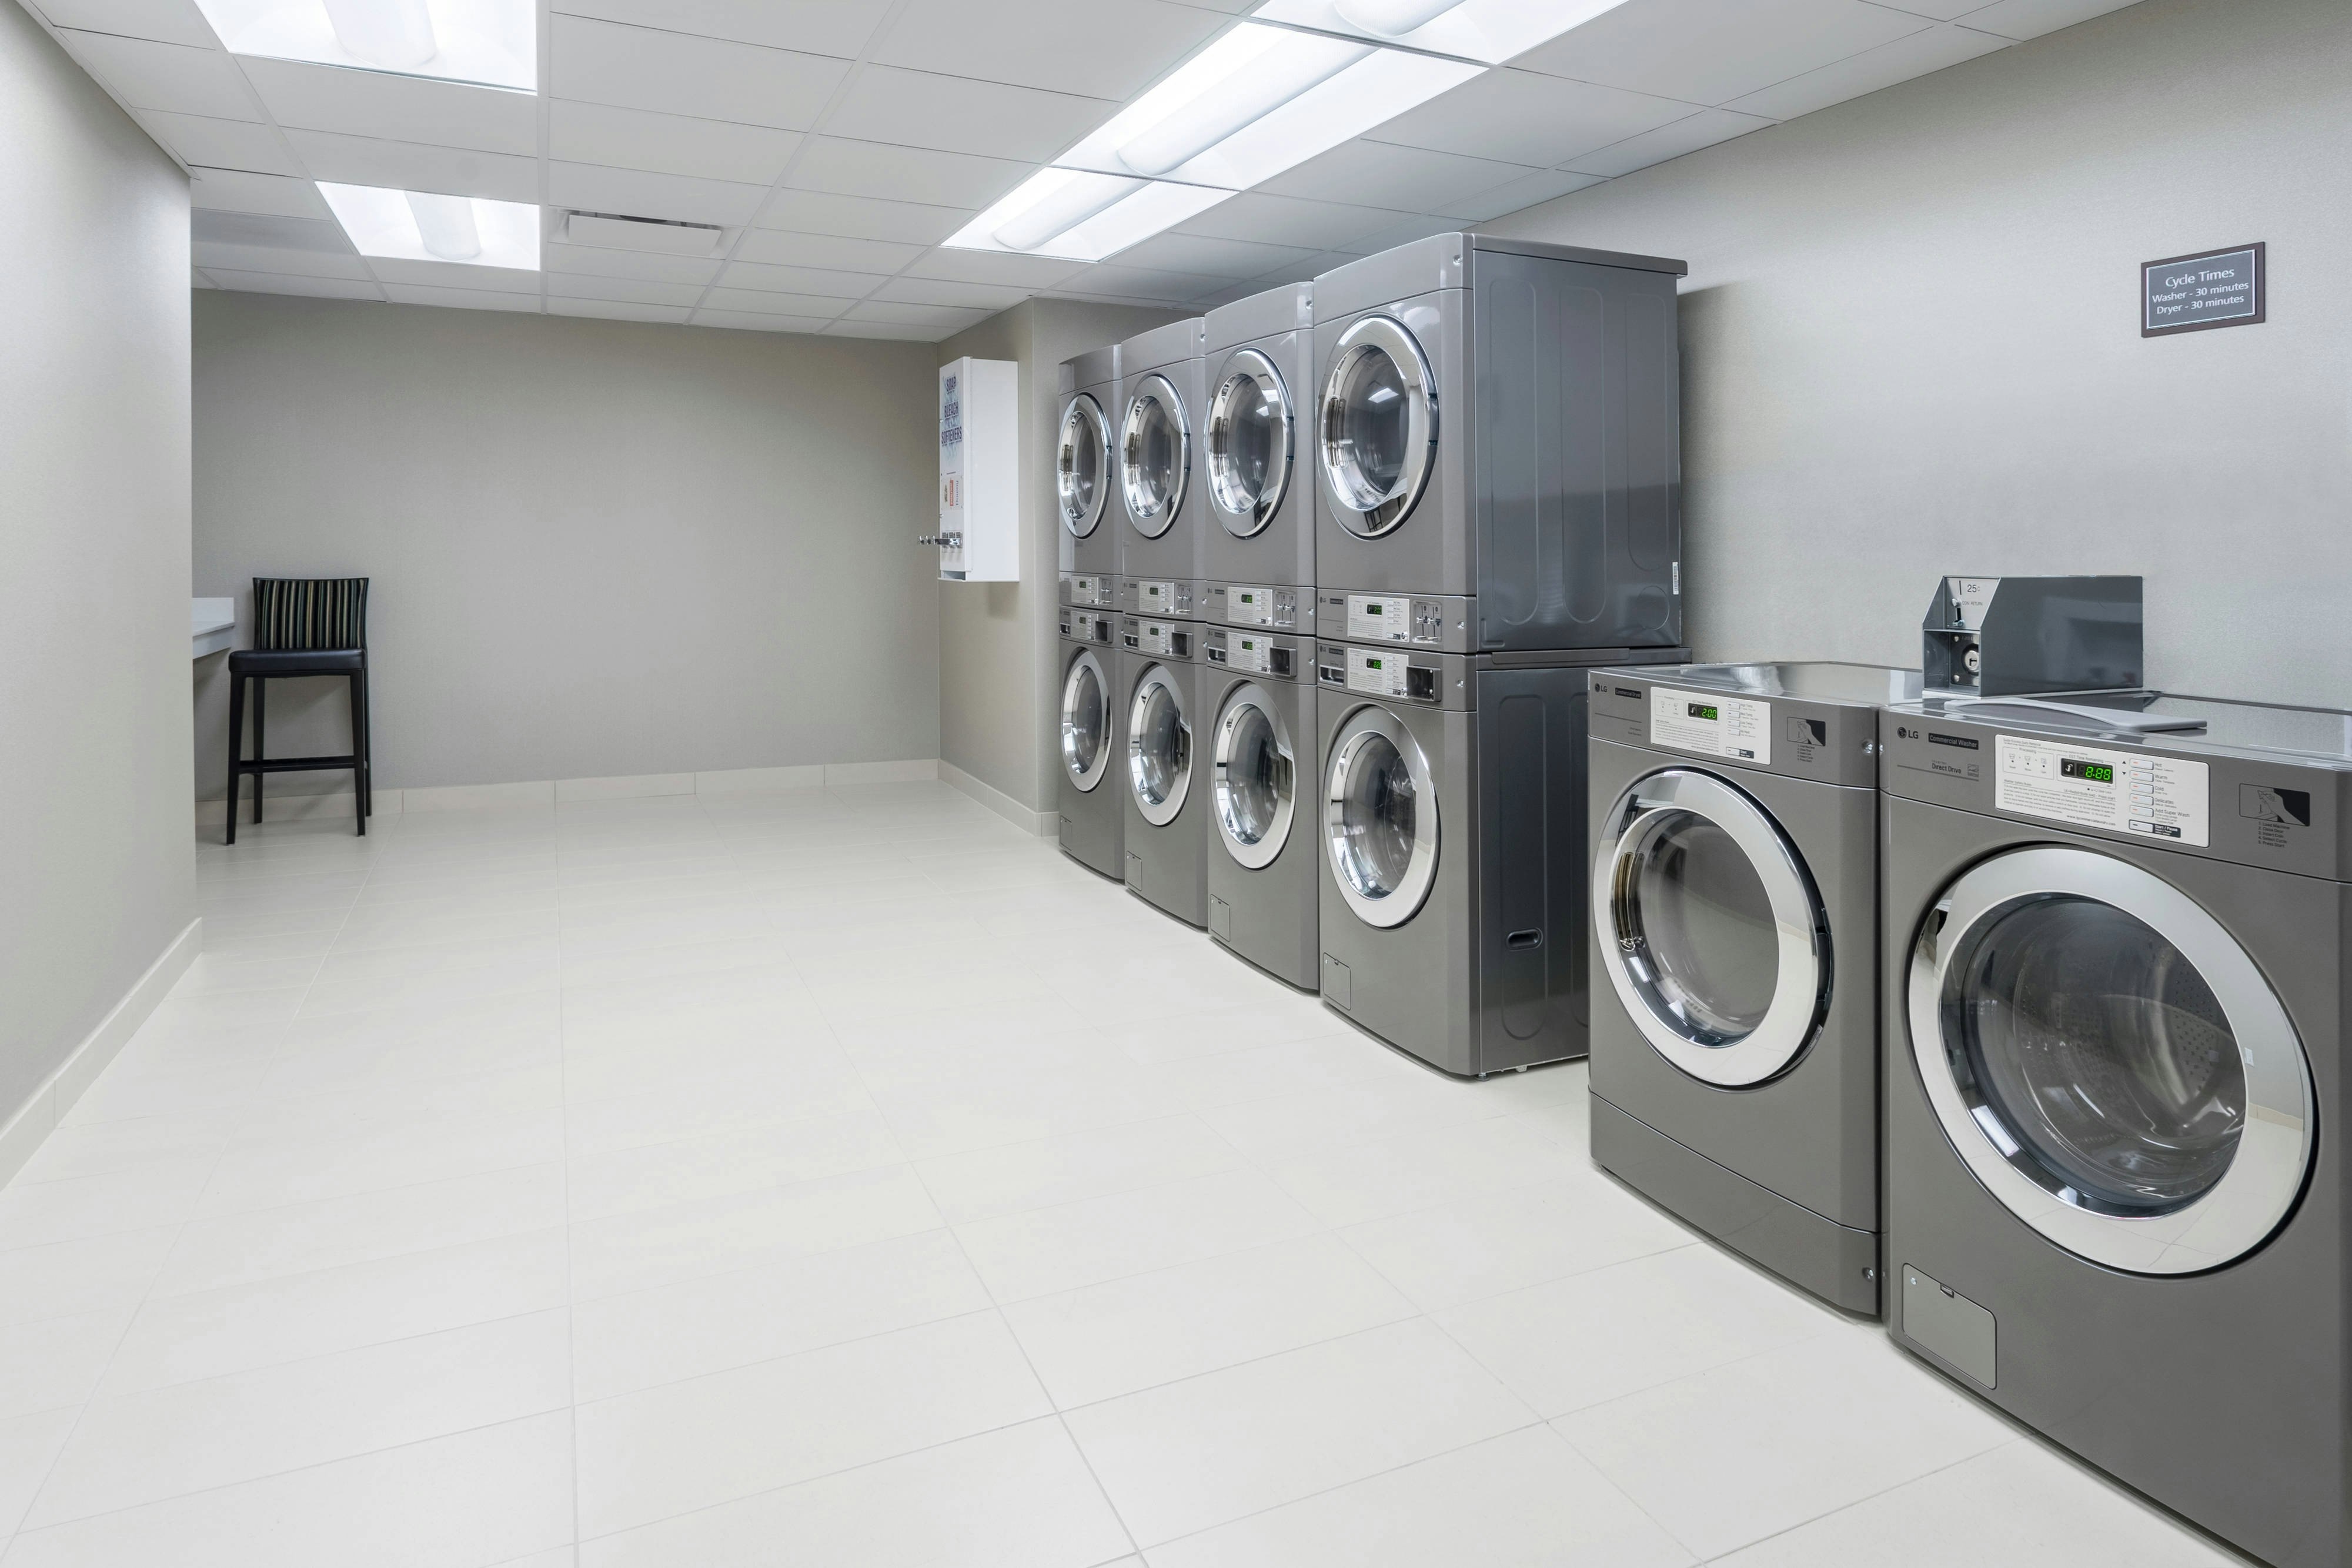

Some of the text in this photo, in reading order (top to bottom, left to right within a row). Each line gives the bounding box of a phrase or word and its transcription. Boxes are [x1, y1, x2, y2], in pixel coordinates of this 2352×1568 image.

[2166, 269, 2235, 289] Cycle Times
[2152, 292, 2187, 303] Washer
[2195, 287, 2207, 296] 30
[2210, 282, 2249, 294] minutes
[2157, 305, 2182, 315] Dryer
[2191, 300, 2203, 309] 30
[2205, 295, 2244, 307] minutes
[944, 401, 958, 418] BLEACH
[941, 426, 962, 444] SOFTENERS
[1908, 730, 1919, 739] LG
[1930, 735, 1977, 747] Commercial Washer
[1932, 763, 1947, 771] Direct
